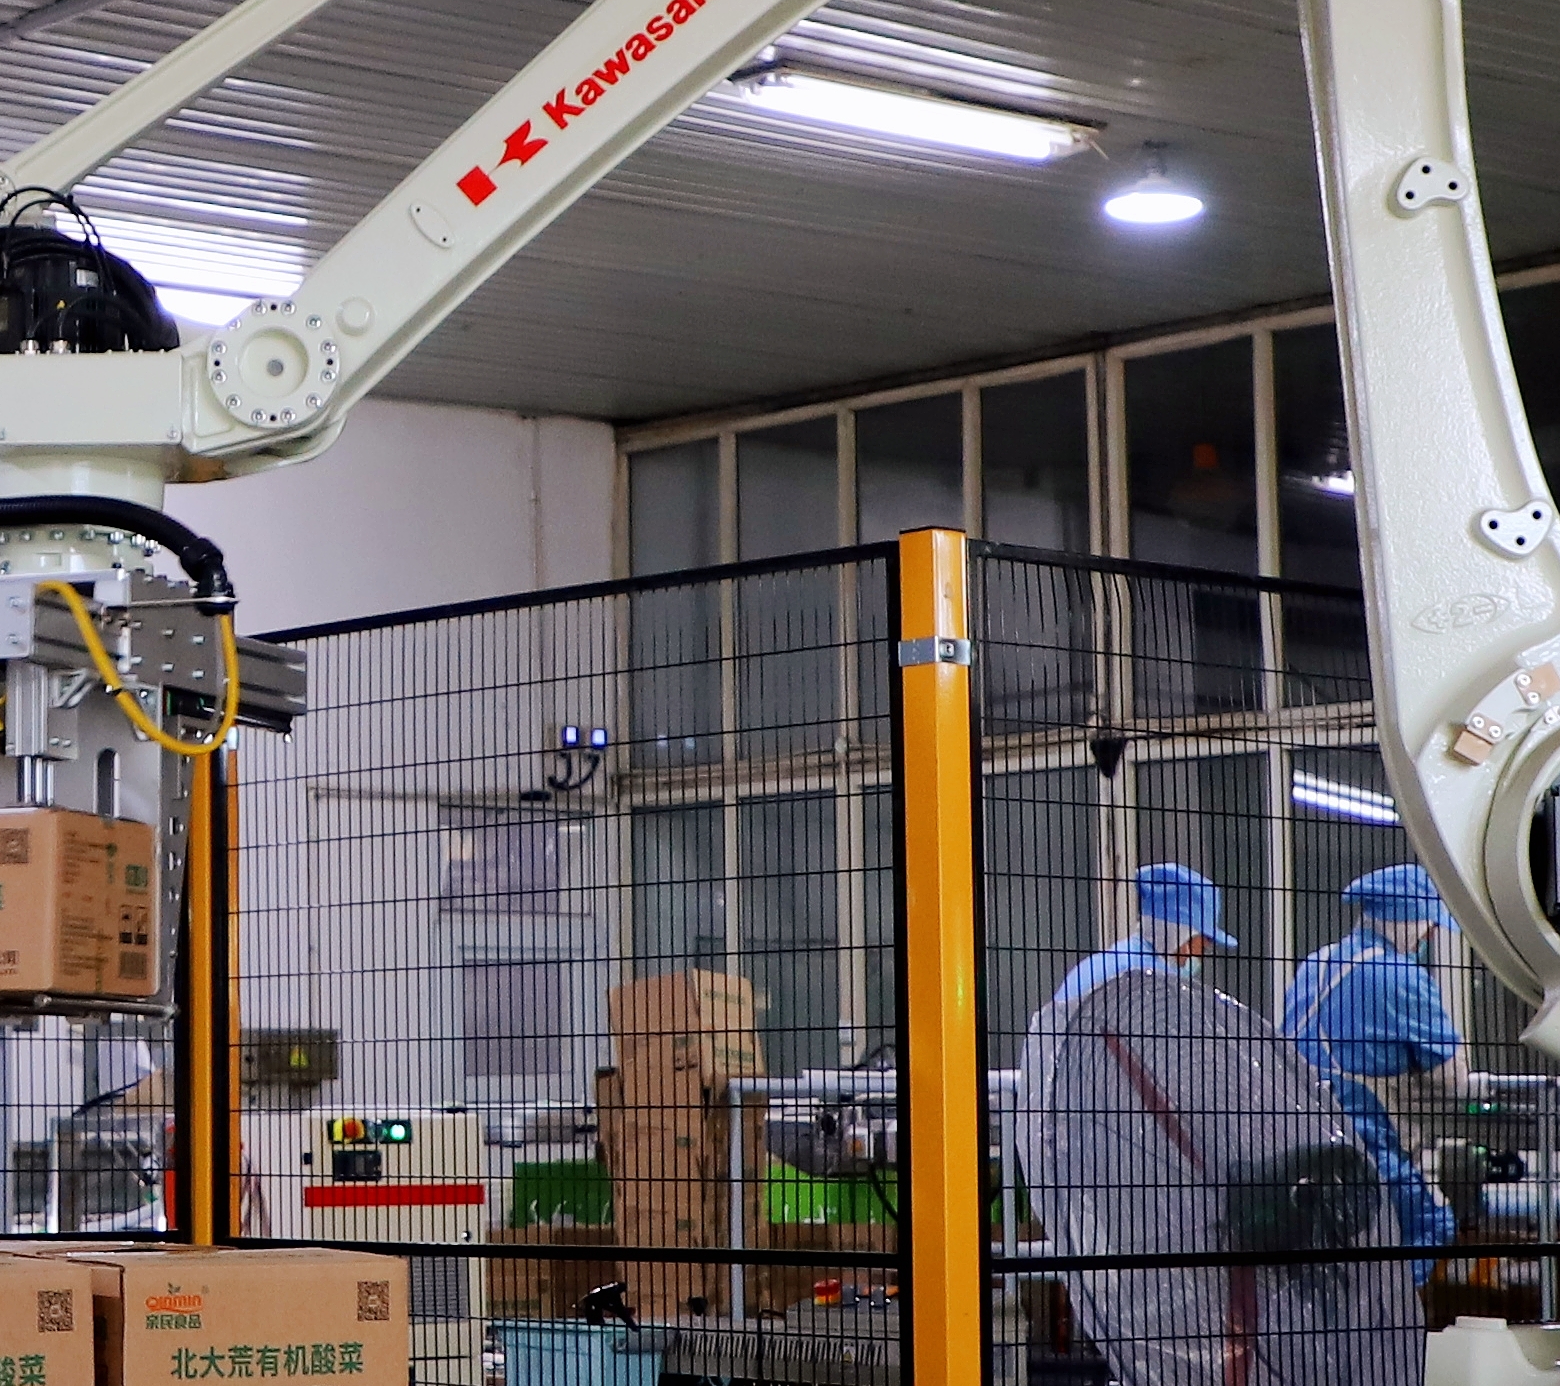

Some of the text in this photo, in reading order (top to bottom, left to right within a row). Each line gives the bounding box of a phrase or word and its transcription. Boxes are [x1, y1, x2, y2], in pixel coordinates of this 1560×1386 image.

[170, 1341, 363, 1380] 北大荒有机酸菜
